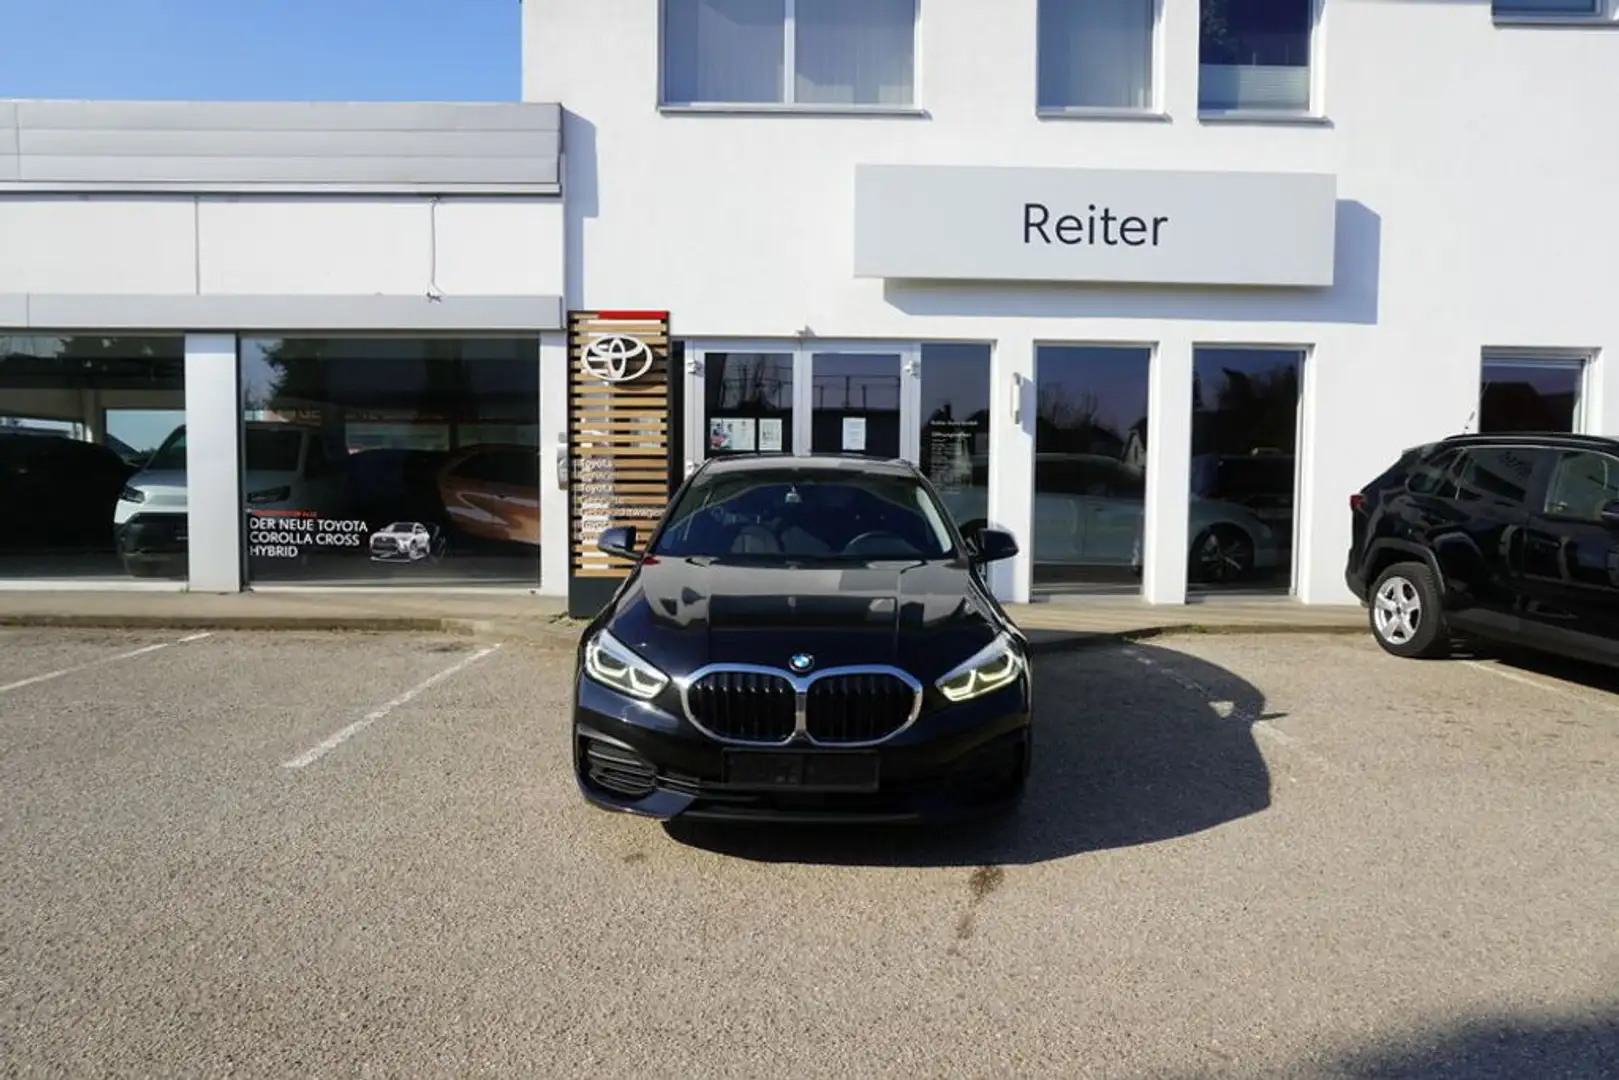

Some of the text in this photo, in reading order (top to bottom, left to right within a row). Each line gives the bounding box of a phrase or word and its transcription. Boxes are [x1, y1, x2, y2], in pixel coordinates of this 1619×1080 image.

[1024, 203, 1169, 246] Reiter
[249, 517, 368, 532] DER NEUE TOYOTA
[249, 531, 360, 545] COROLLA CROSS
[249, 545, 298, 557] HYBRID
